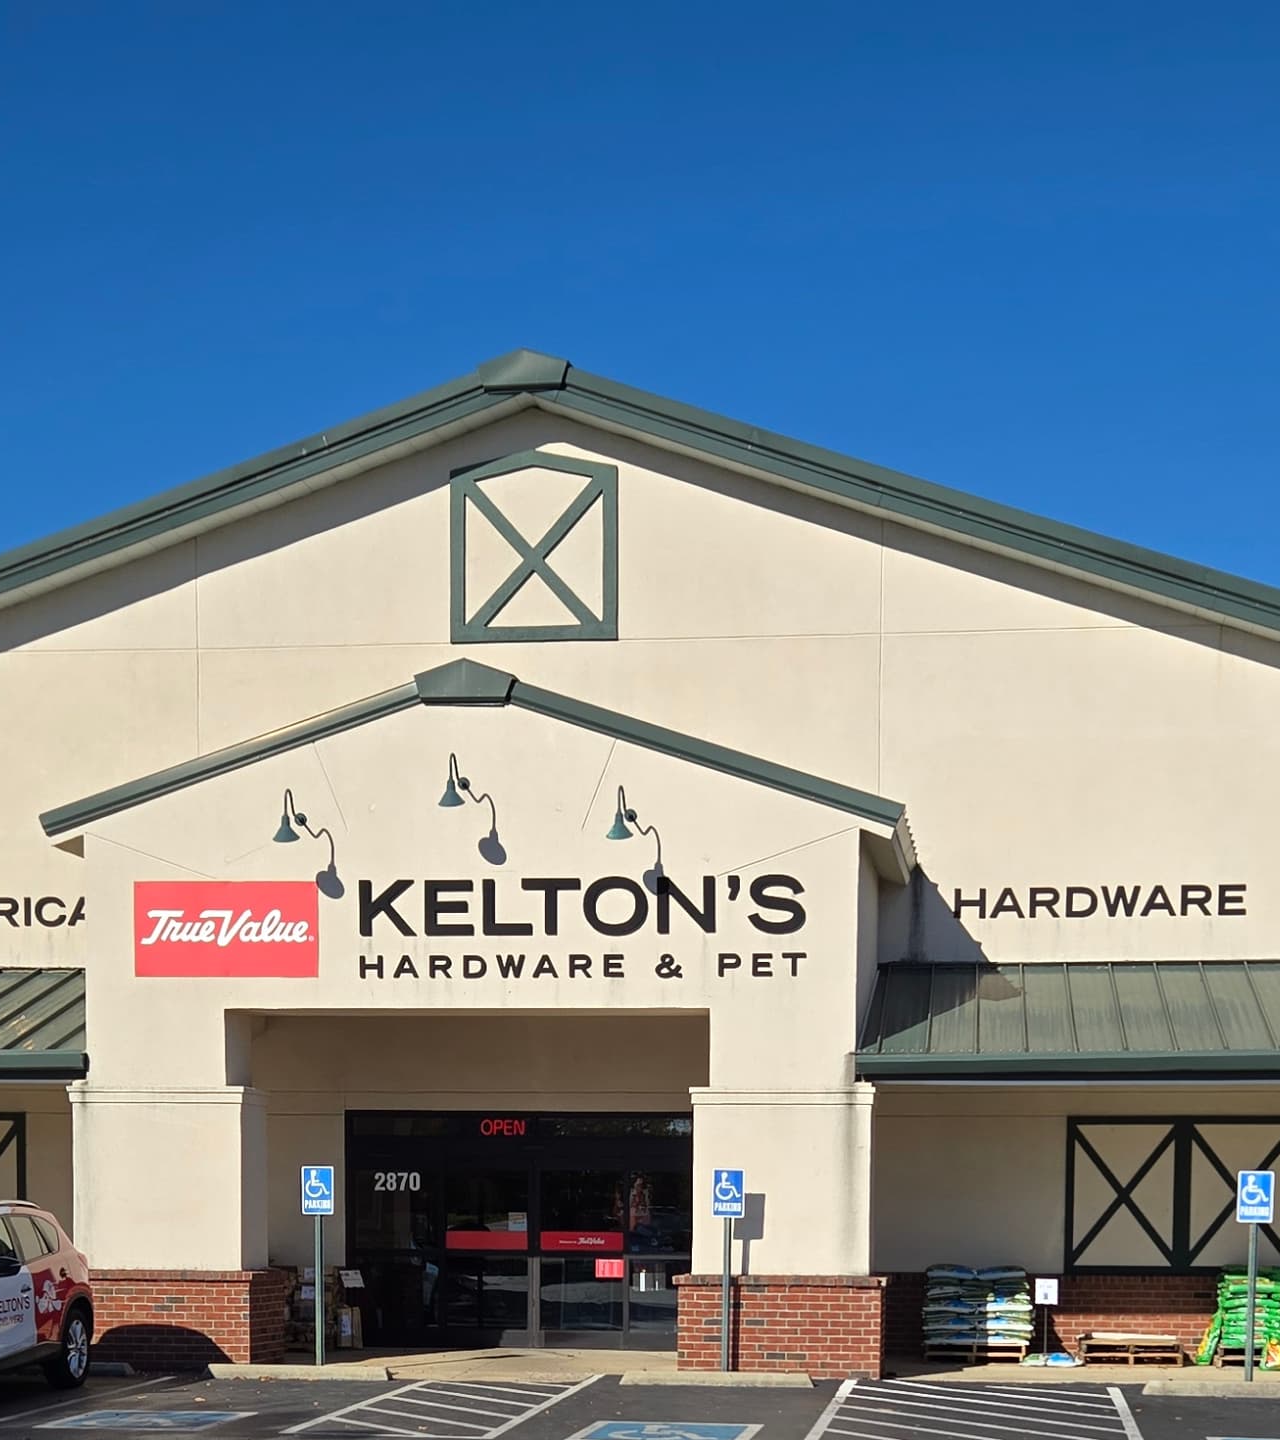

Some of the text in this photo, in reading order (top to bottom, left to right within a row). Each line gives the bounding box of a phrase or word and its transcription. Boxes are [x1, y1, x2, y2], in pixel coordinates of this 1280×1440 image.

[358, 873, 807, 937] KELTON'S
[953, 883, 1247, 919] HARDWARE
[359, 951, 807, 979] HARDWARE & PET
[480, 1119, 525, 1136] OPEN
[374, 1172, 421, 1191] 2870
[304, 1199, 331, 1209] PARKING
[714, 1202, 742, 1211] PARKING
[1239, 1206, 1270, 1216] PARKING
